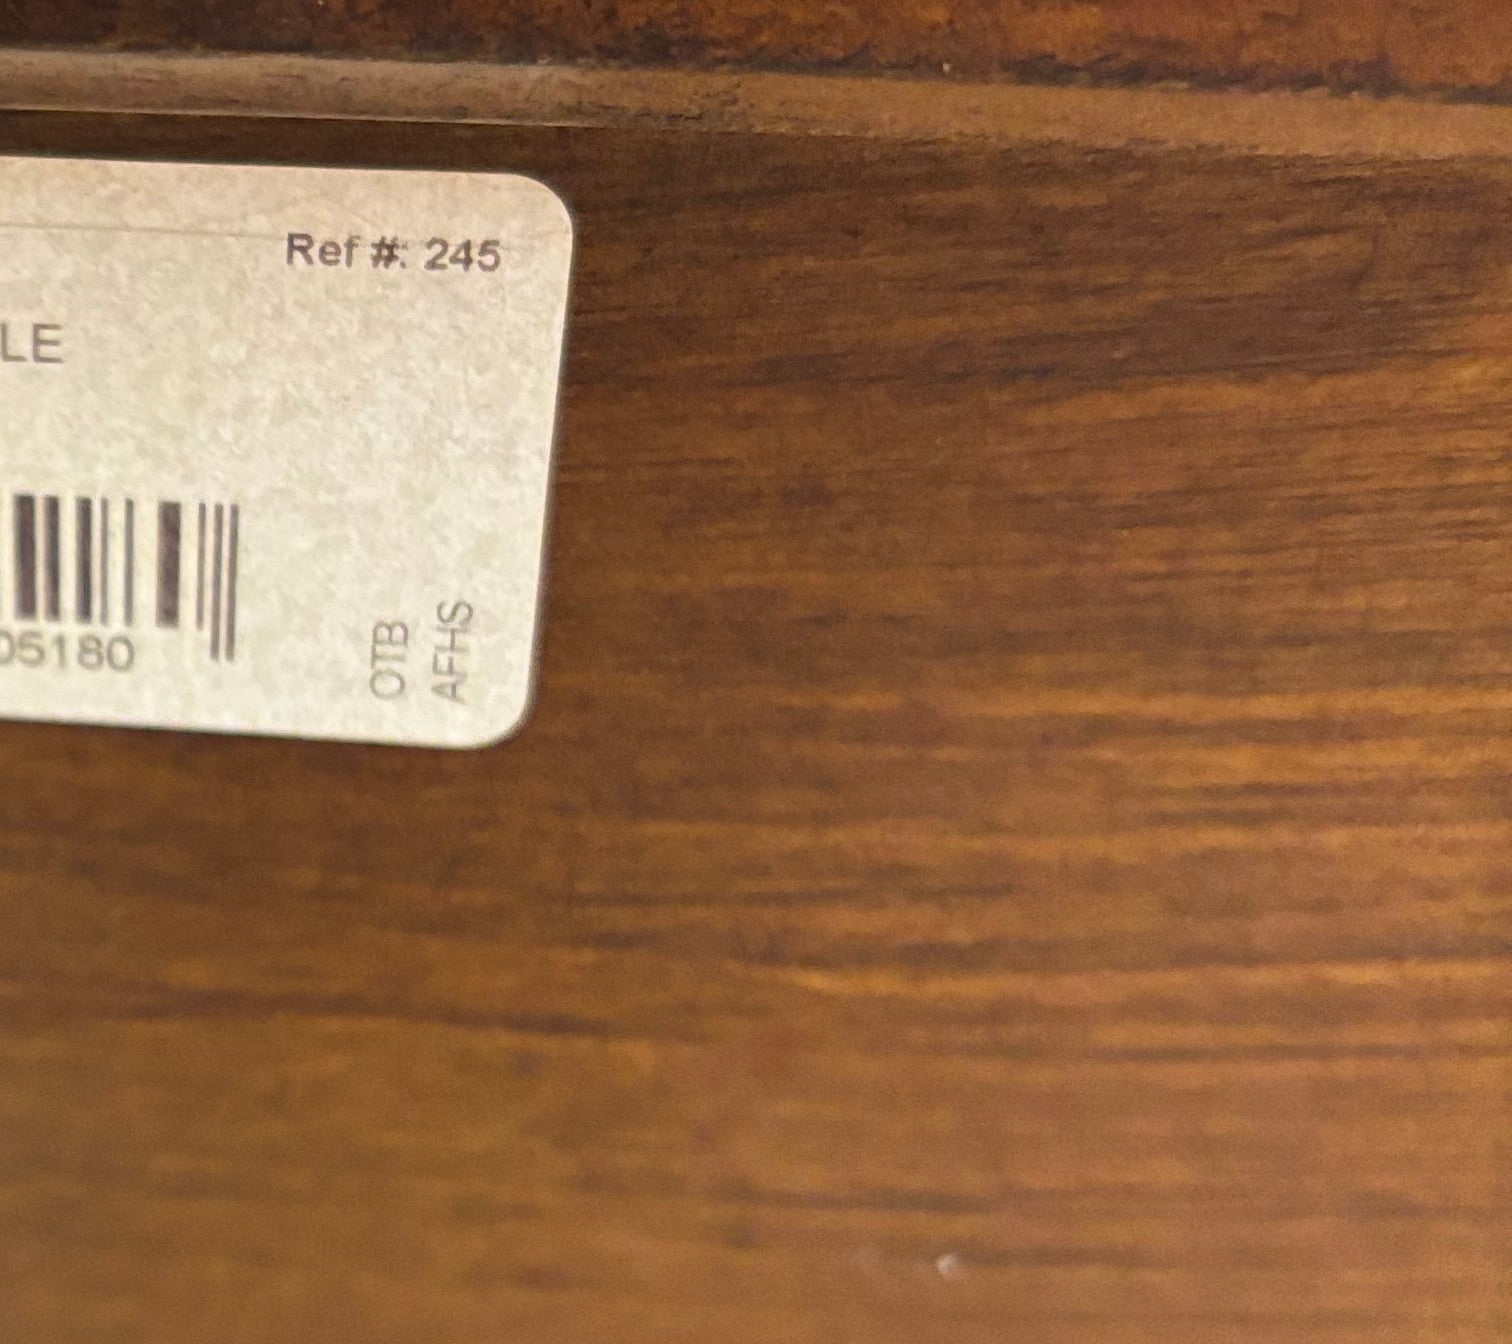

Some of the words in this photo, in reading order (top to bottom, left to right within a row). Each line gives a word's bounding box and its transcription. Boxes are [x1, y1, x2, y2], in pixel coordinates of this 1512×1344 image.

[286, 232, 360, 267] Ref
[424, 239, 501, 272] 245
[369, 620, 408, 701] OTB
[432, 599, 473, 704] AFHS
